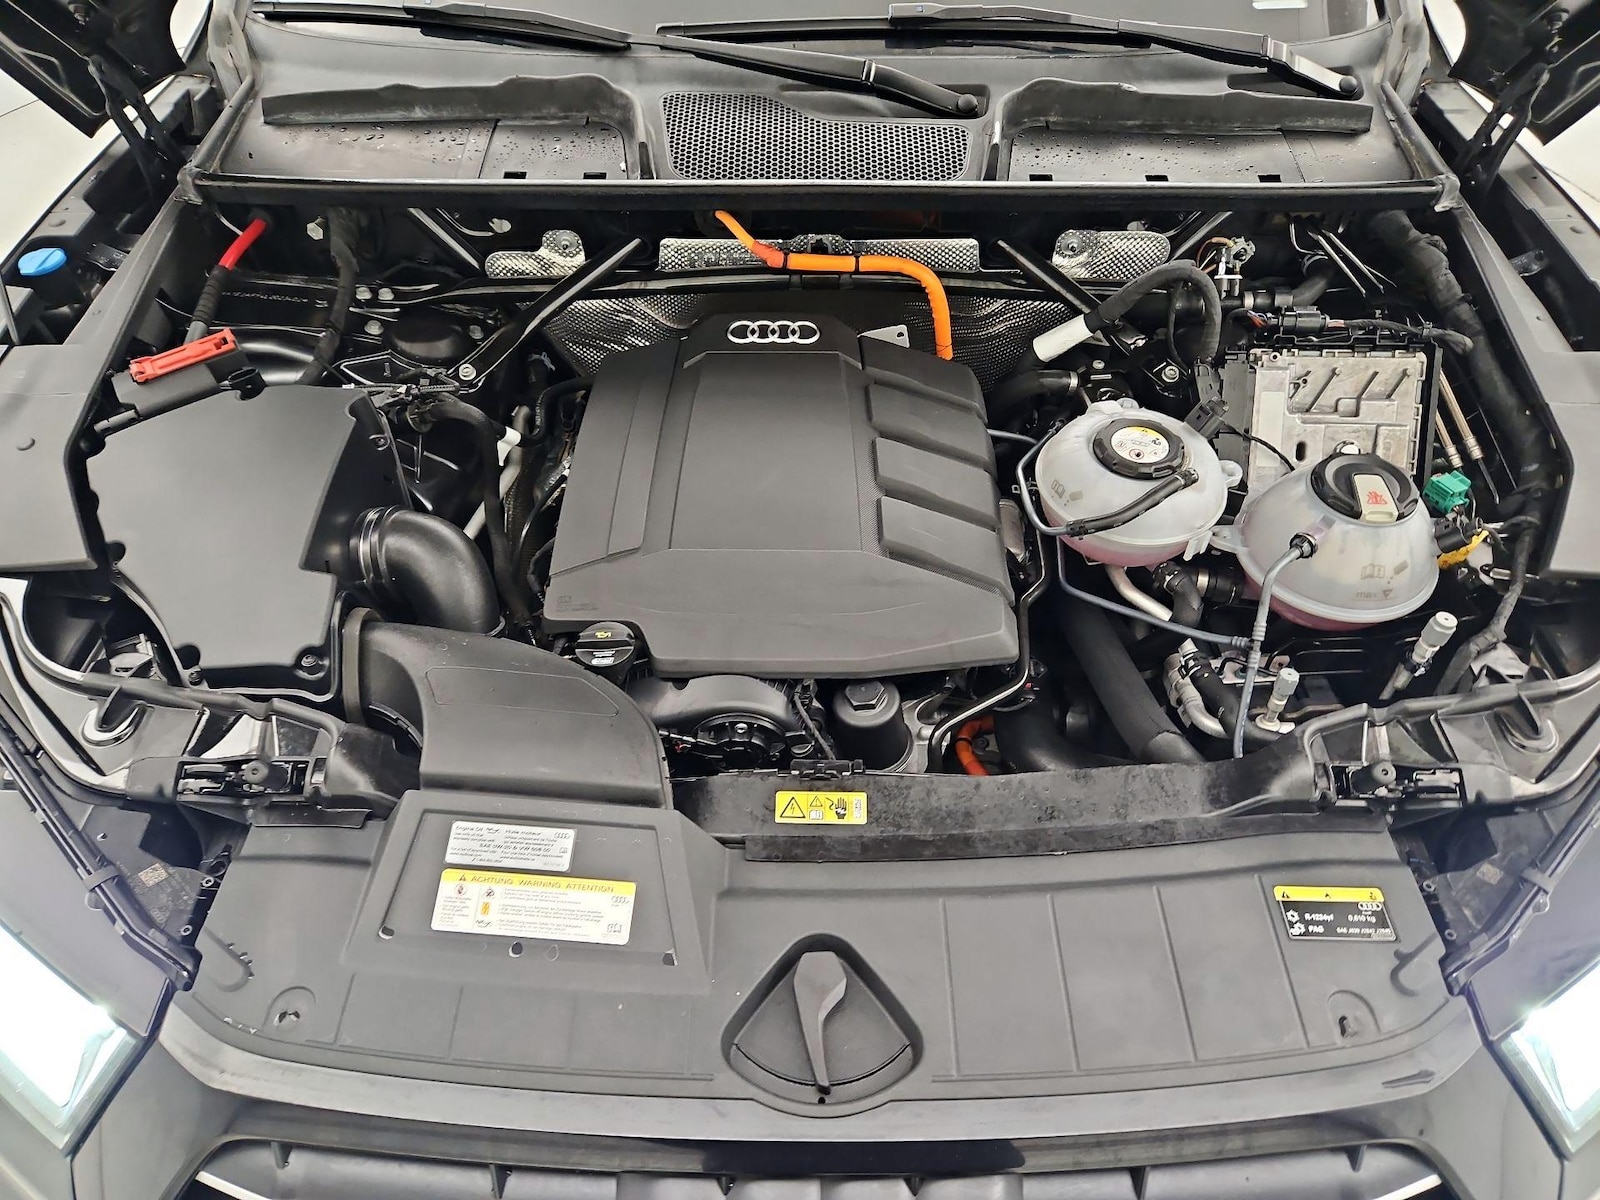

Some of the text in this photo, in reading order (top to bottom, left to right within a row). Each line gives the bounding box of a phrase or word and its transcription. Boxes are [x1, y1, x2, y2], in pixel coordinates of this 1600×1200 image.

[471, 875, 615, 893] ACHTUNG WARNING ATTENTION
